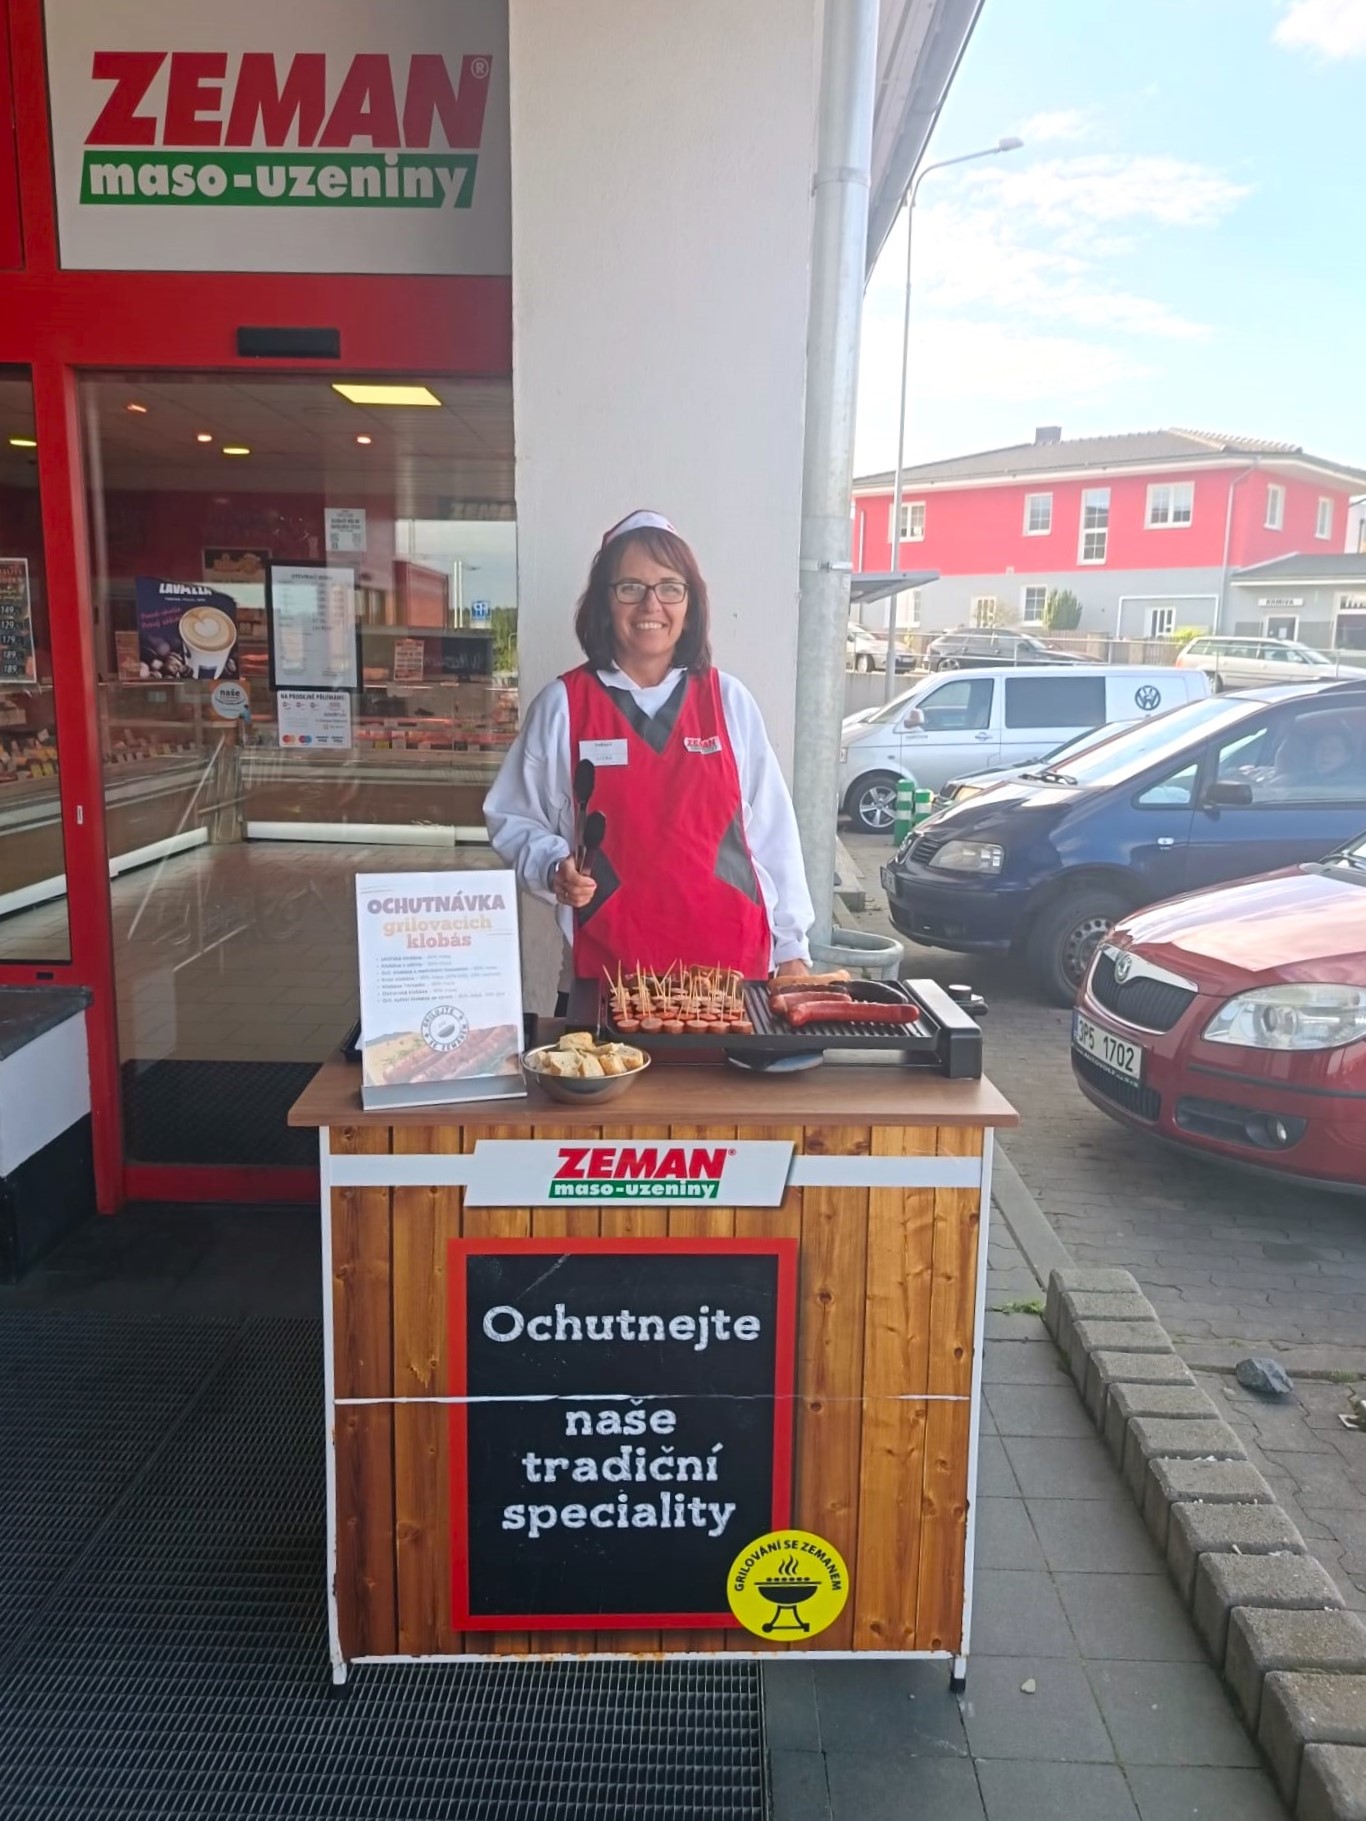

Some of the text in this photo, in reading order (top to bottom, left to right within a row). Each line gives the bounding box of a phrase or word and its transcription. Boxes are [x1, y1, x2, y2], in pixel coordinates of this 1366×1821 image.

[84, 52, 493, 148] ZEMAN
[89, 153, 469, 207] maso-uzeniny
[367, 890, 506, 914] OCHUTNÁVKA
[406, 932, 472, 949] klobás
[1103, 1035, 1135, 1073] 1702
[553, 1148, 727, 1179] ZEMAN
[554, 1180, 716, 1198] maso-uzeniny
[482, 1303, 761, 1351] Ochutnejte
[565, 1398, 677, 1436] naše
[521, 1442, 723, 1482] tradiční
[502, 1491, 736, 1538] speciality
[734, 1540, 842, 1592] GRILOVÁNÍ SE ZEMANEM
